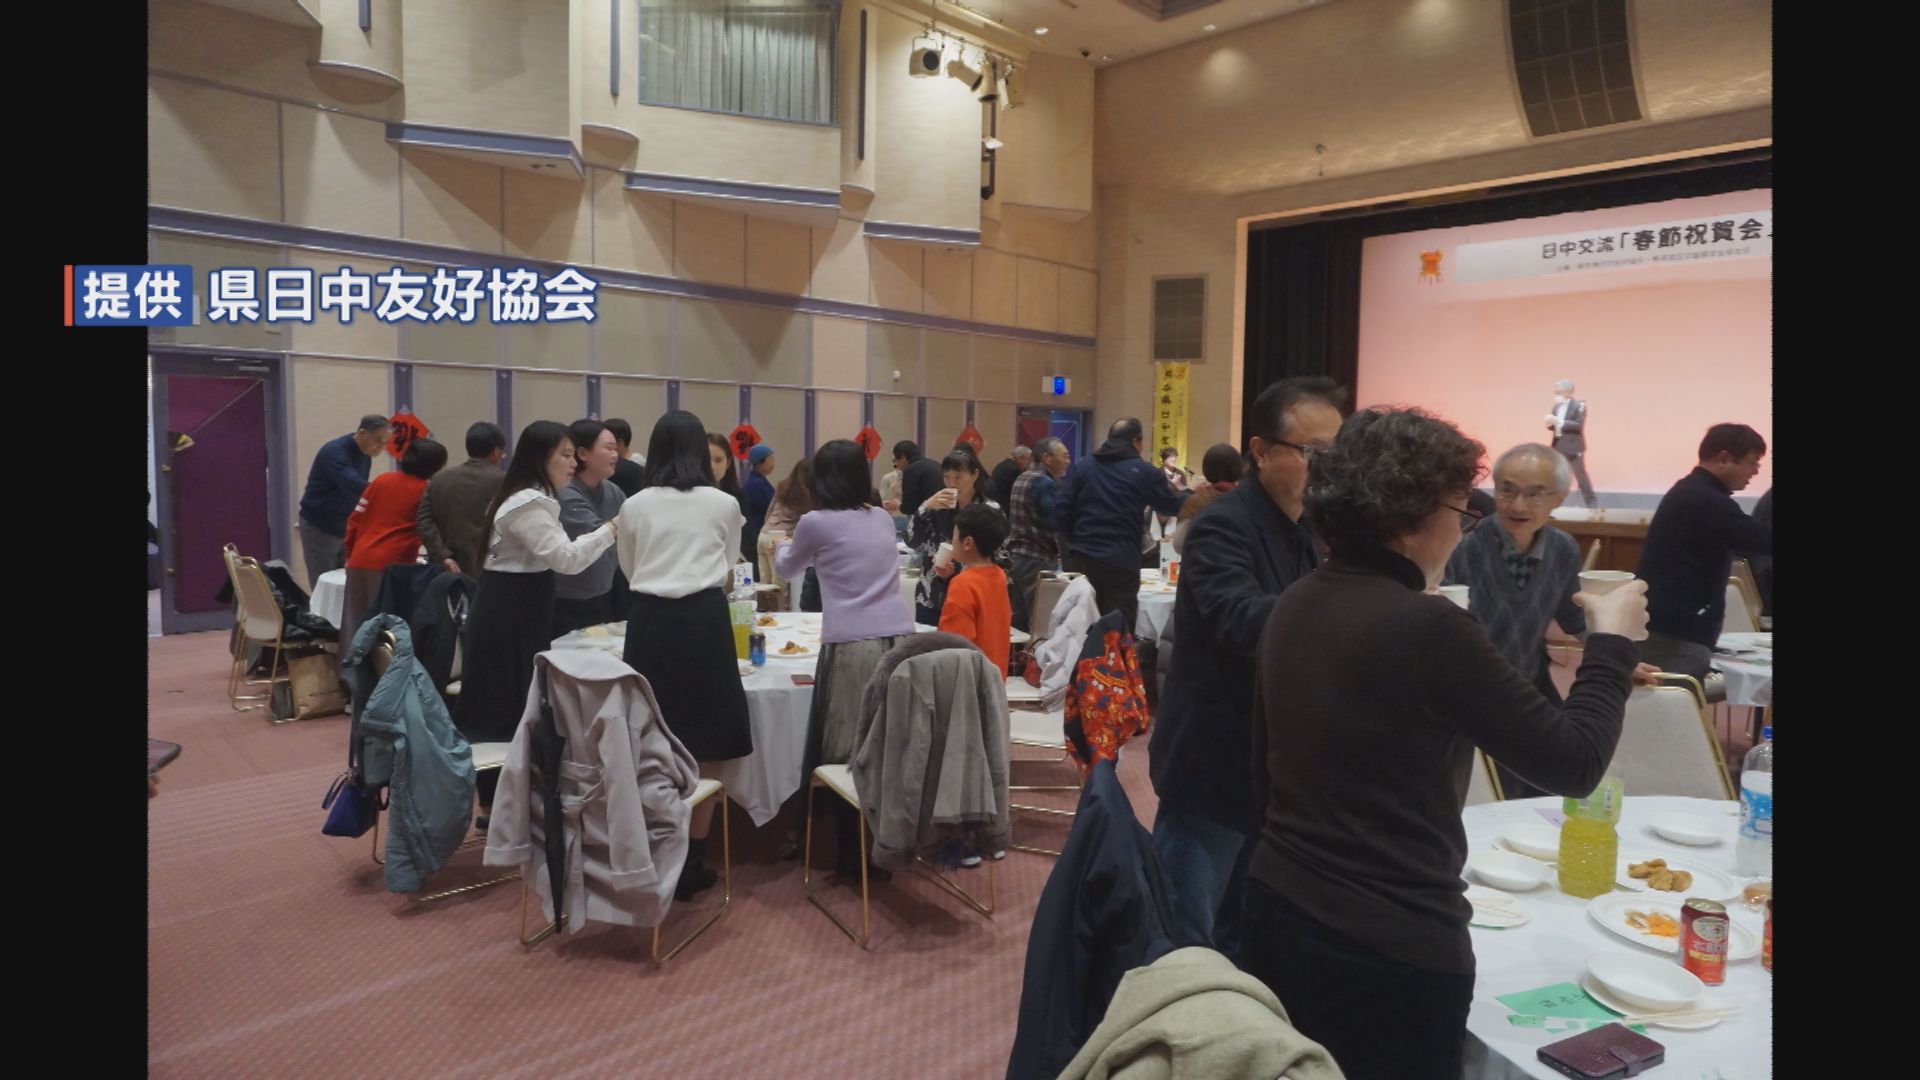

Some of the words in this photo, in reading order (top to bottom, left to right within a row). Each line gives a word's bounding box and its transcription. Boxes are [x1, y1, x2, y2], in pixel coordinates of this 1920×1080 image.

[1542, 218, 1772, 259] 日中交流「春節祝賀会
